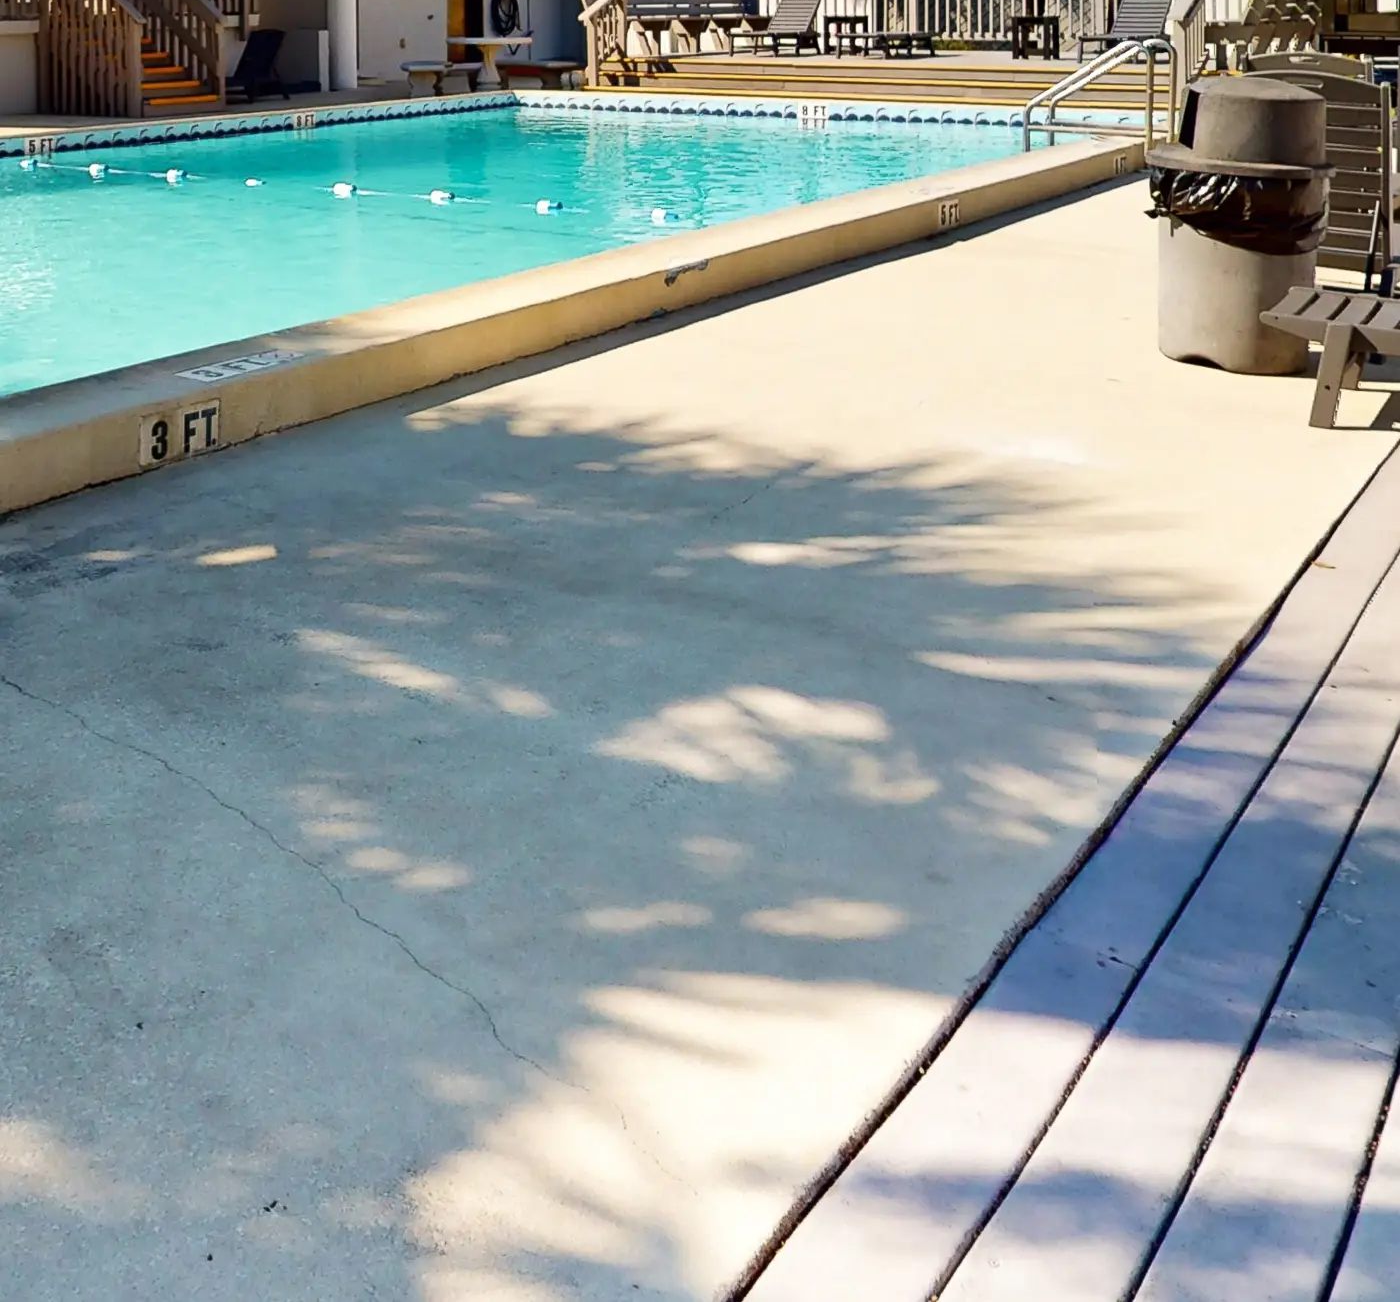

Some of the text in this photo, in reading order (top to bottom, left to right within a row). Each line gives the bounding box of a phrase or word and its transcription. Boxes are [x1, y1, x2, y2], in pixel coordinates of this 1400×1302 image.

[802, 105, 827, 117] 8 FT
[305, 113, 315, 126] FT
[28, 139, 36, 154] 5
[941, 204, 947, 226] 5
[151, 407, 217, 460] 3 FT.
